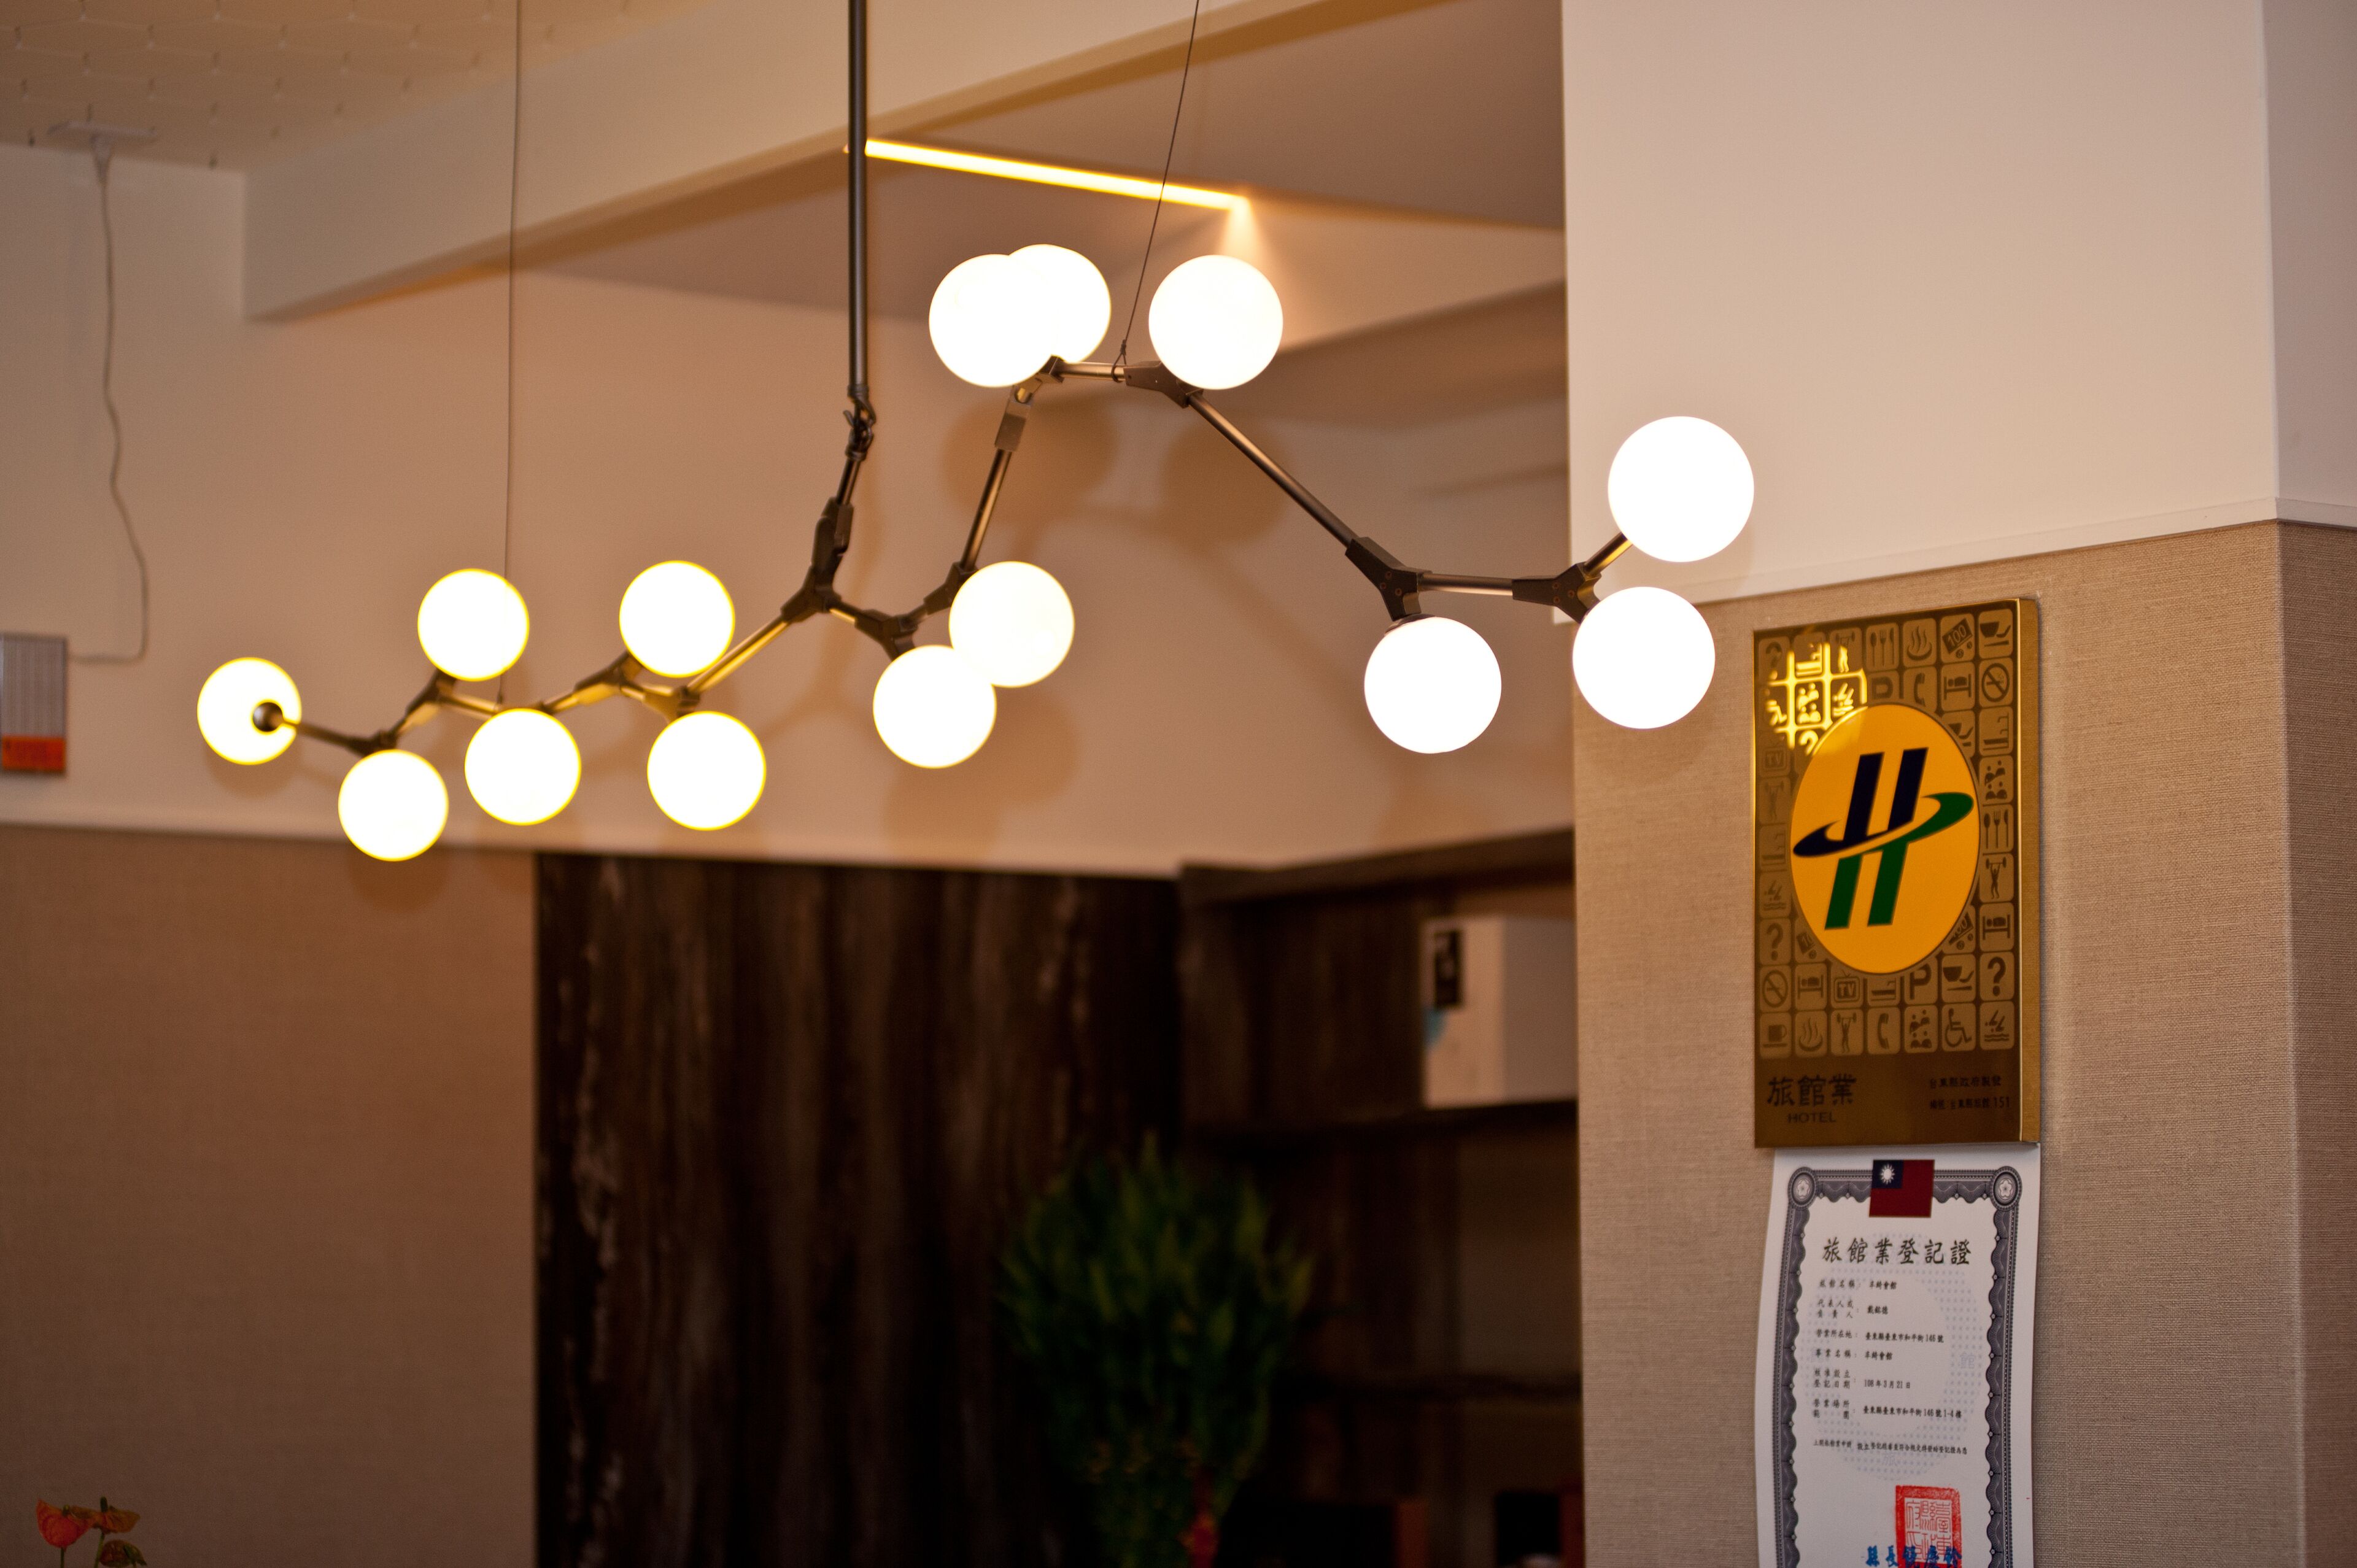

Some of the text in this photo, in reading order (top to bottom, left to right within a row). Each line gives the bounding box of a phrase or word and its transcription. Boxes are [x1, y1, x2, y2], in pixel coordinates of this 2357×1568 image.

[1767, 1073, 1857, 1106] 旅館業
[1787, 1111, 1836, 1124] HOTEL
[1822, 1237, 1972, 1266] 旅館業登記證
[1813, 1379, 1850, 1390] 登記日期
